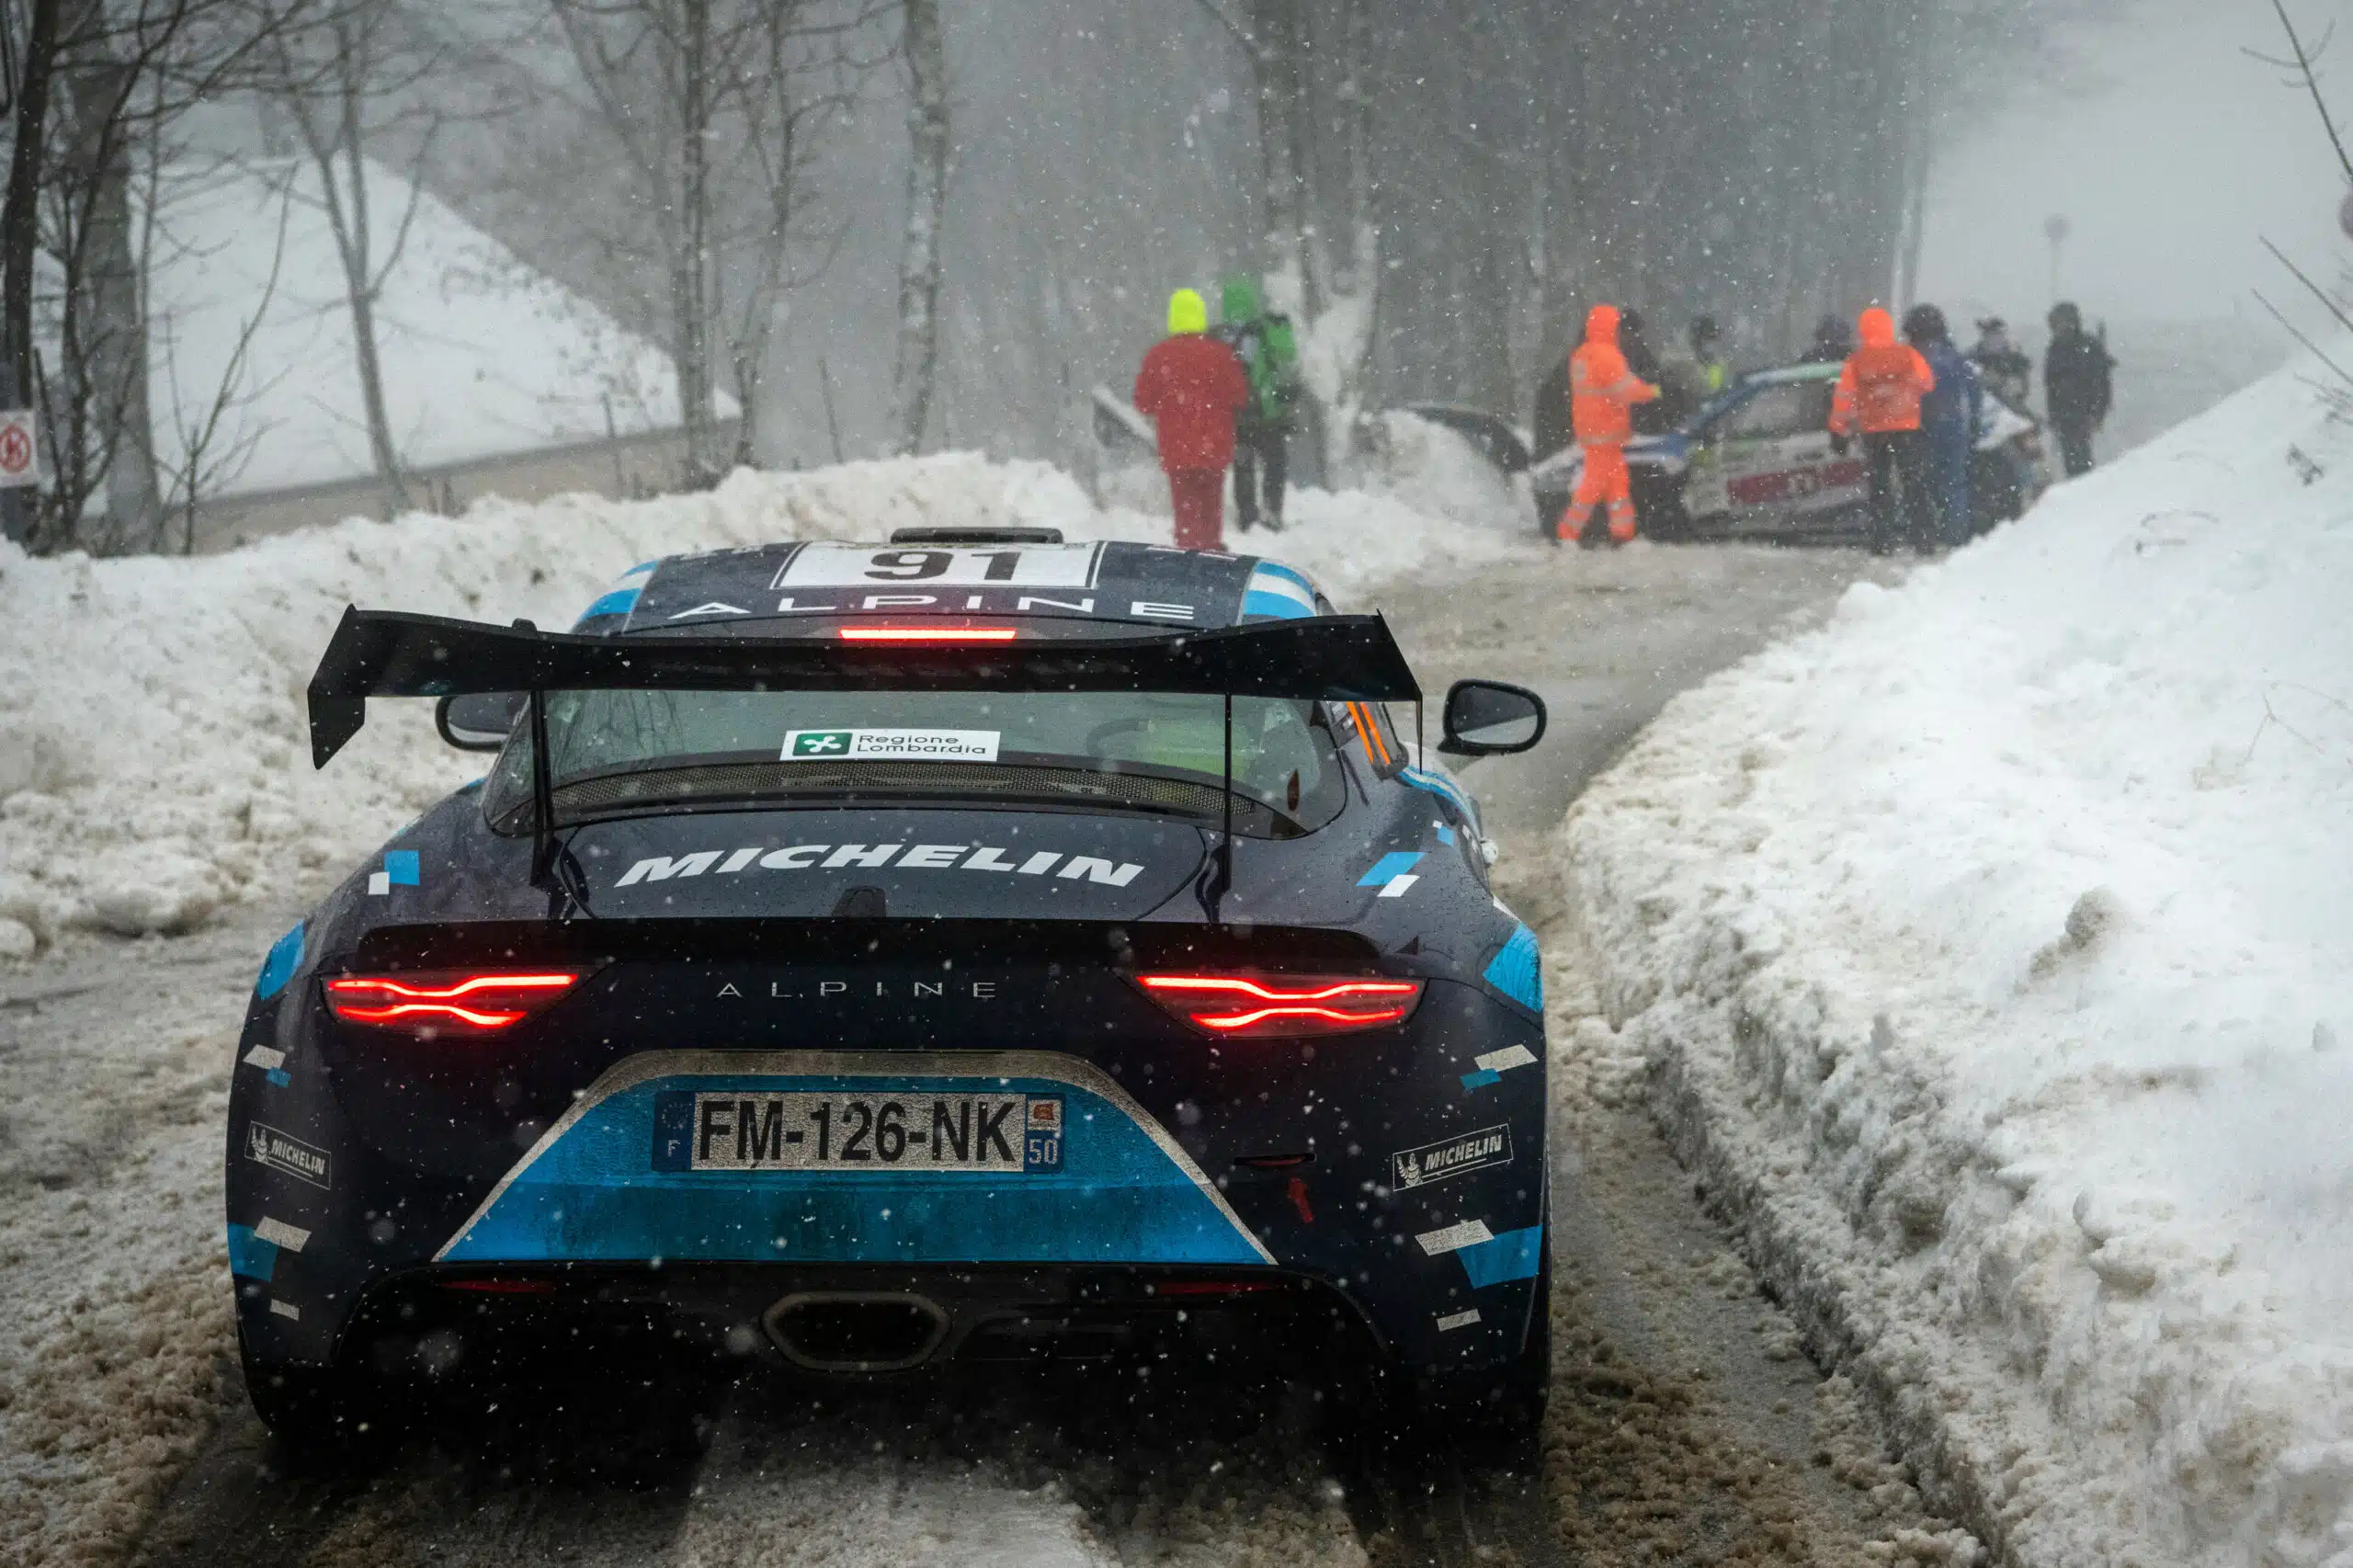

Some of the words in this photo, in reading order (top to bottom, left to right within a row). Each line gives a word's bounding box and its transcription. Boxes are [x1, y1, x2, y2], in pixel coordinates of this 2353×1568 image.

[863, 551, 1022, 581] 91
[666, 595, 1194, 620] ALPINE
[857, 743, 986, 755] Lombardia
[858, 734, 960, 744] Regione
[613, 843, 1145, 888] MICHELIN
[716, 982, 996, 998] ALPINE
[699, 1100, 1017, 1162] FM-126-NK
[270, 1138, 325, 1176] MICHELIN
[668, 1139, 680, 1157] F
[1029, 1139, 1058, 1165] 50
[1424, 1134, 1503, 1171] MICHELIN
